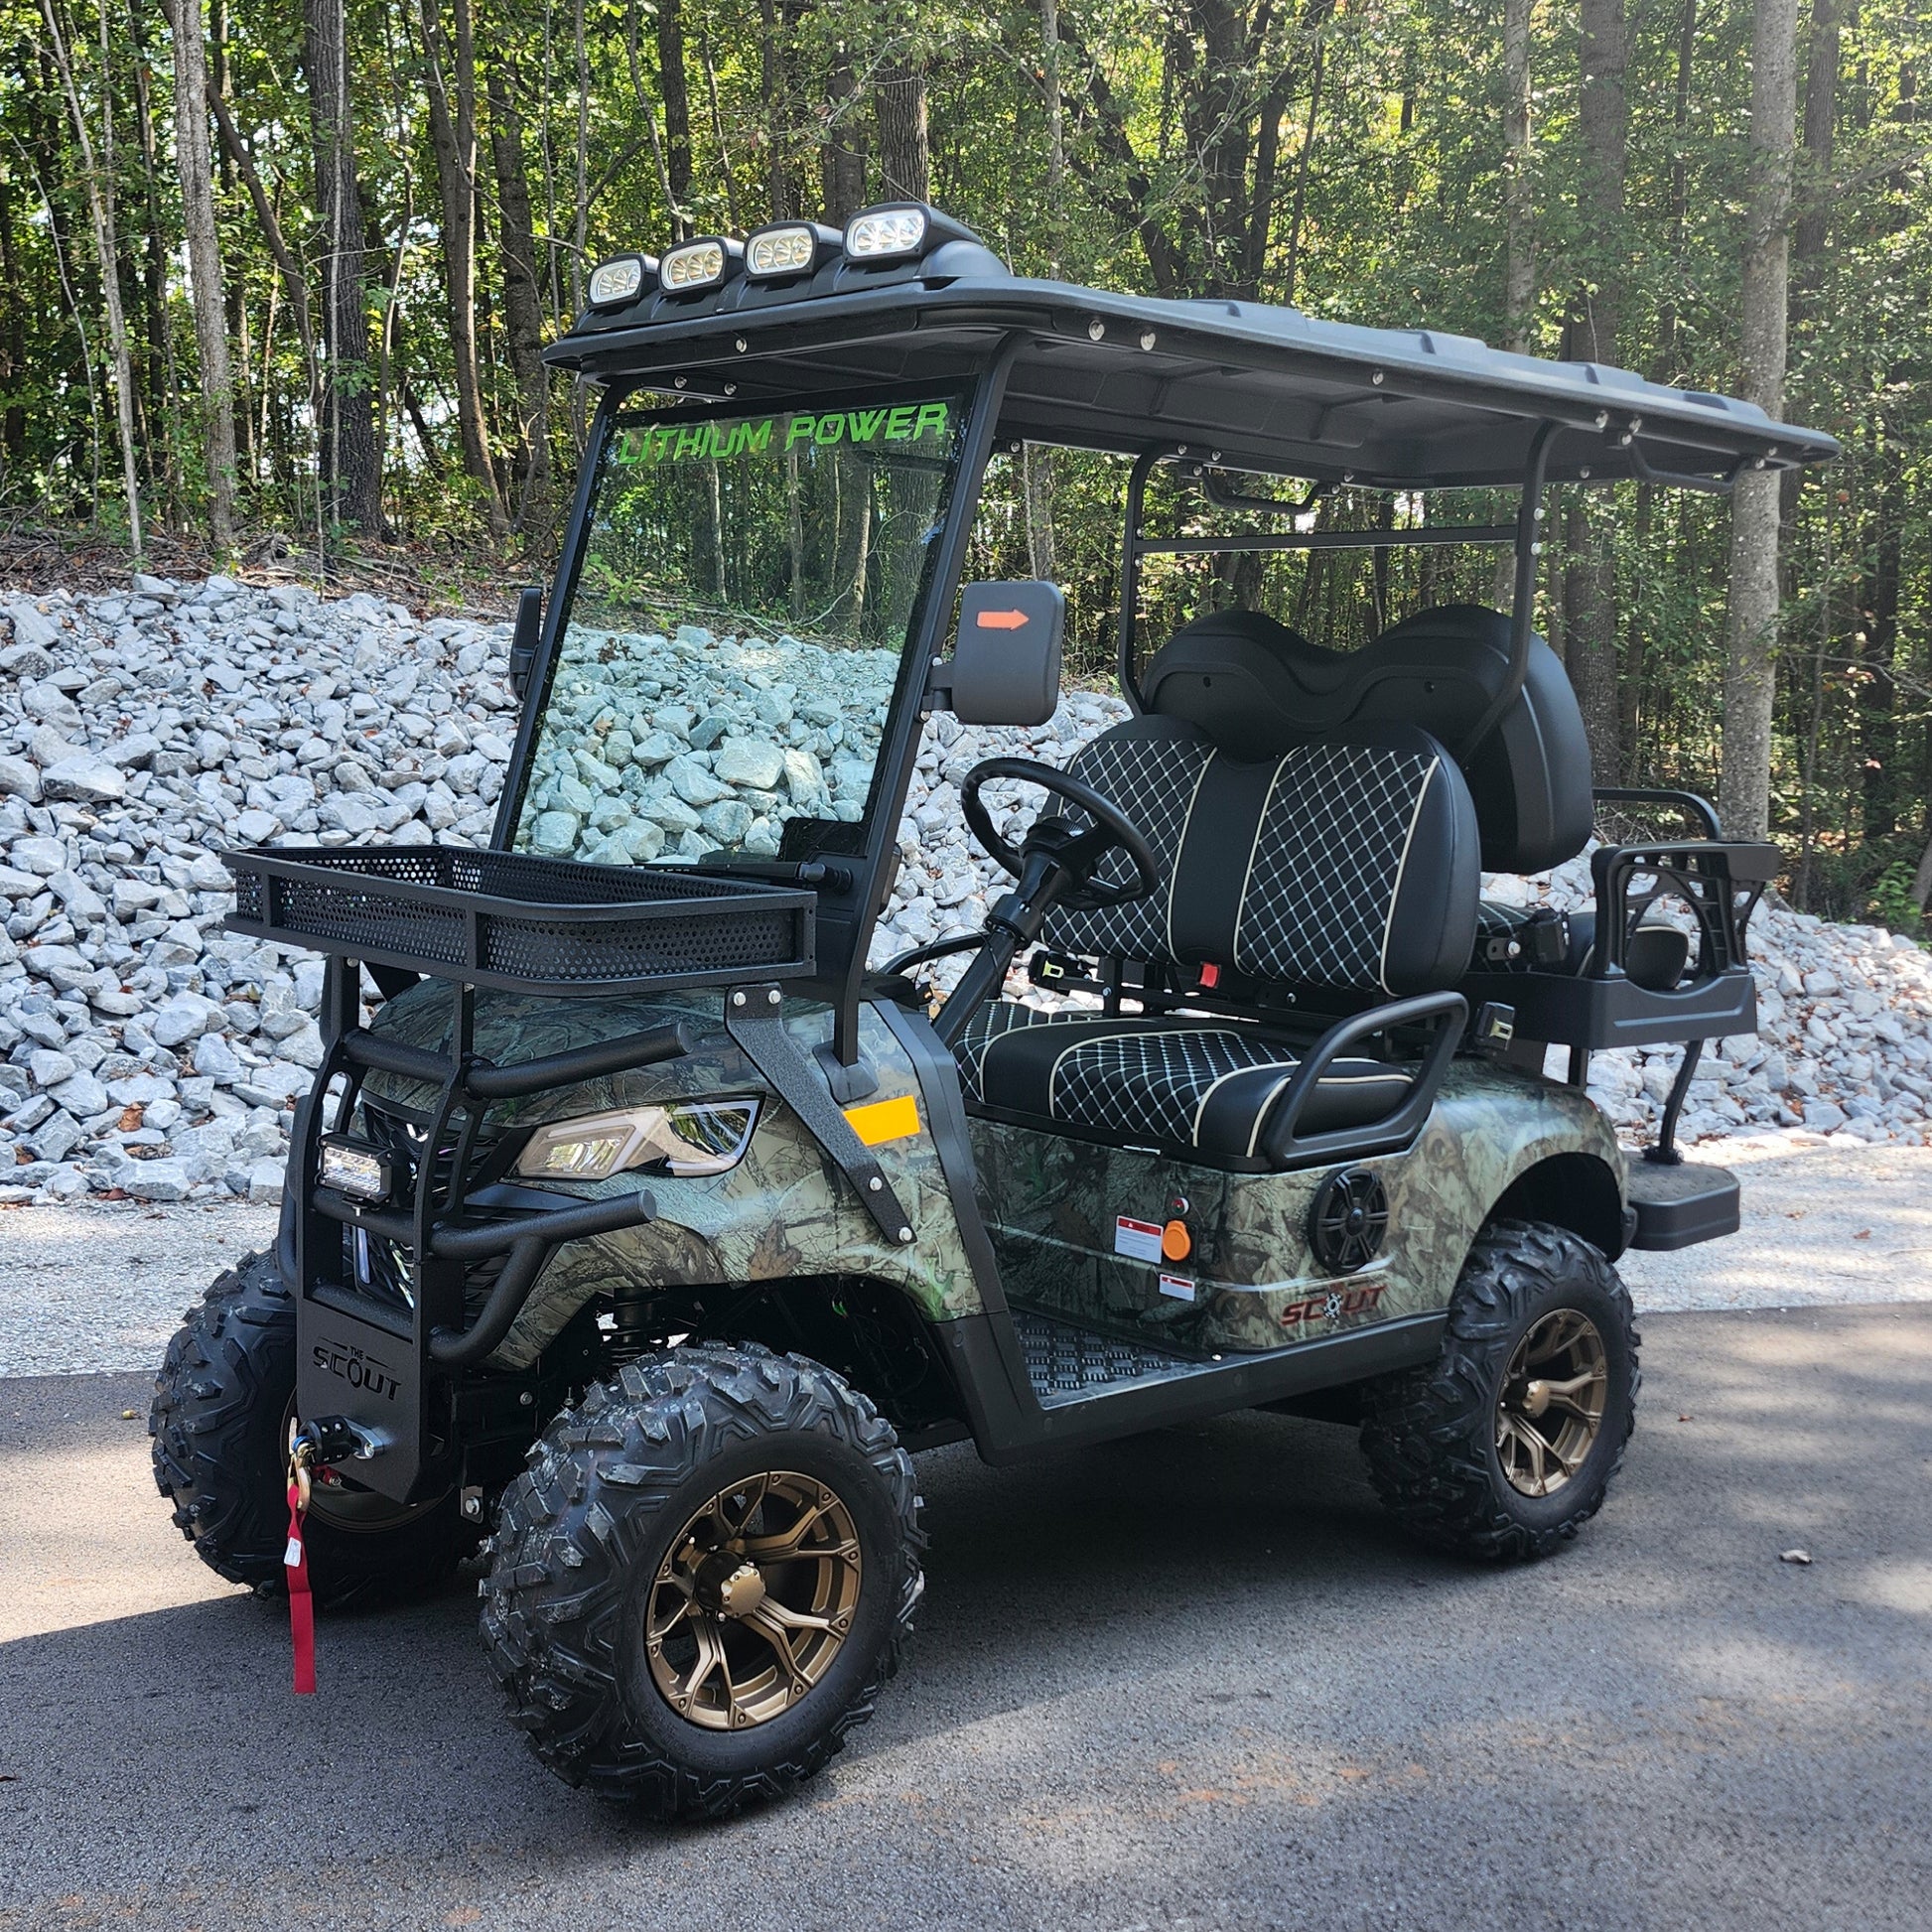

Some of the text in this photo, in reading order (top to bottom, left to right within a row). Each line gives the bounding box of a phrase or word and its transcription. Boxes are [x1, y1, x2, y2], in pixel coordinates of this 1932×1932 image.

[619, 402, 948, 465] LITHIUM POWER
[1280, 1284, 1387, 1325] SCOUT
[313, 1346, 402, 1401] SCOUT
[349, 1345, 364, 1360] THE
